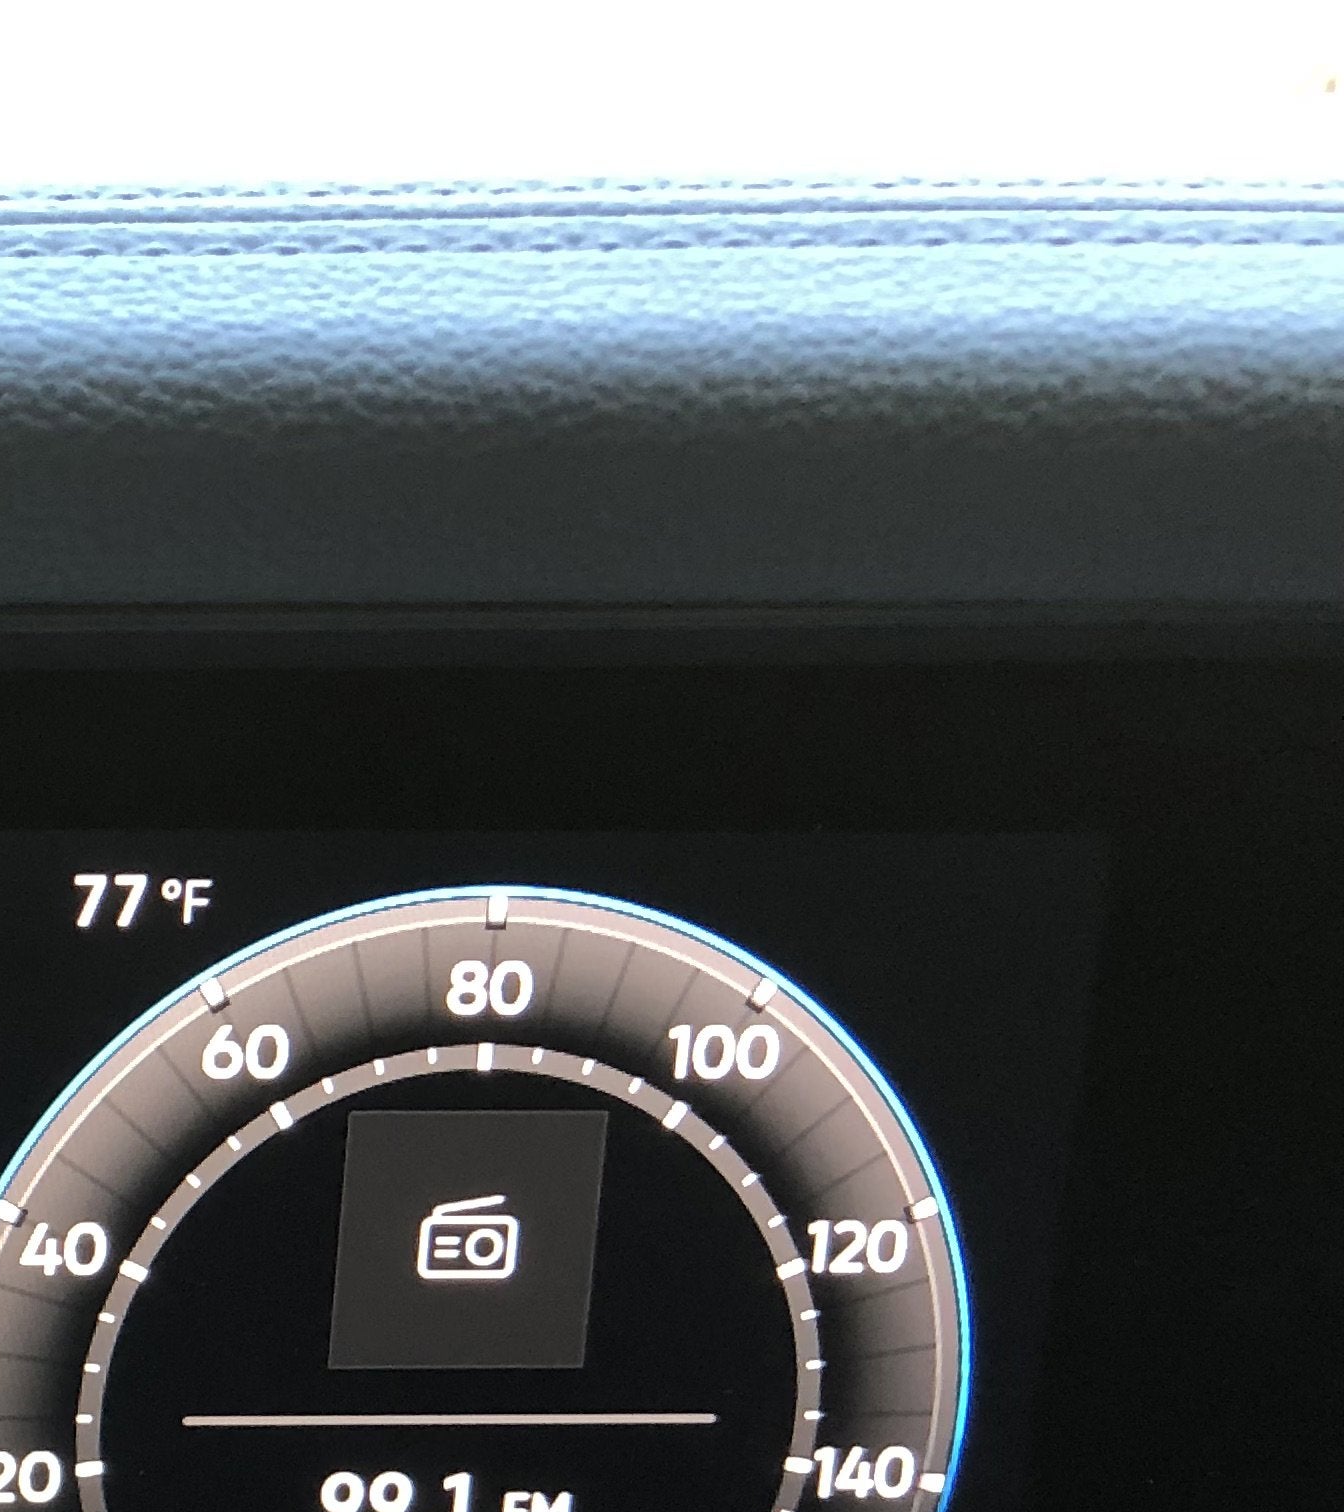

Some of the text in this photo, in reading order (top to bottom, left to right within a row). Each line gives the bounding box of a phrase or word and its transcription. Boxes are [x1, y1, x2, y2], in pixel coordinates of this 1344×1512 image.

[74, 874, 148, 927] 77
[447, 960, 533, 1016] 80
[201, 1024, 290, 1080] 60
[668, 1025, 780, 1080] 100
[19, 1222, 108, 1276] 40
[808, 1220, 908, 1274] 120
[814, 1446, 915, 1499] 140
